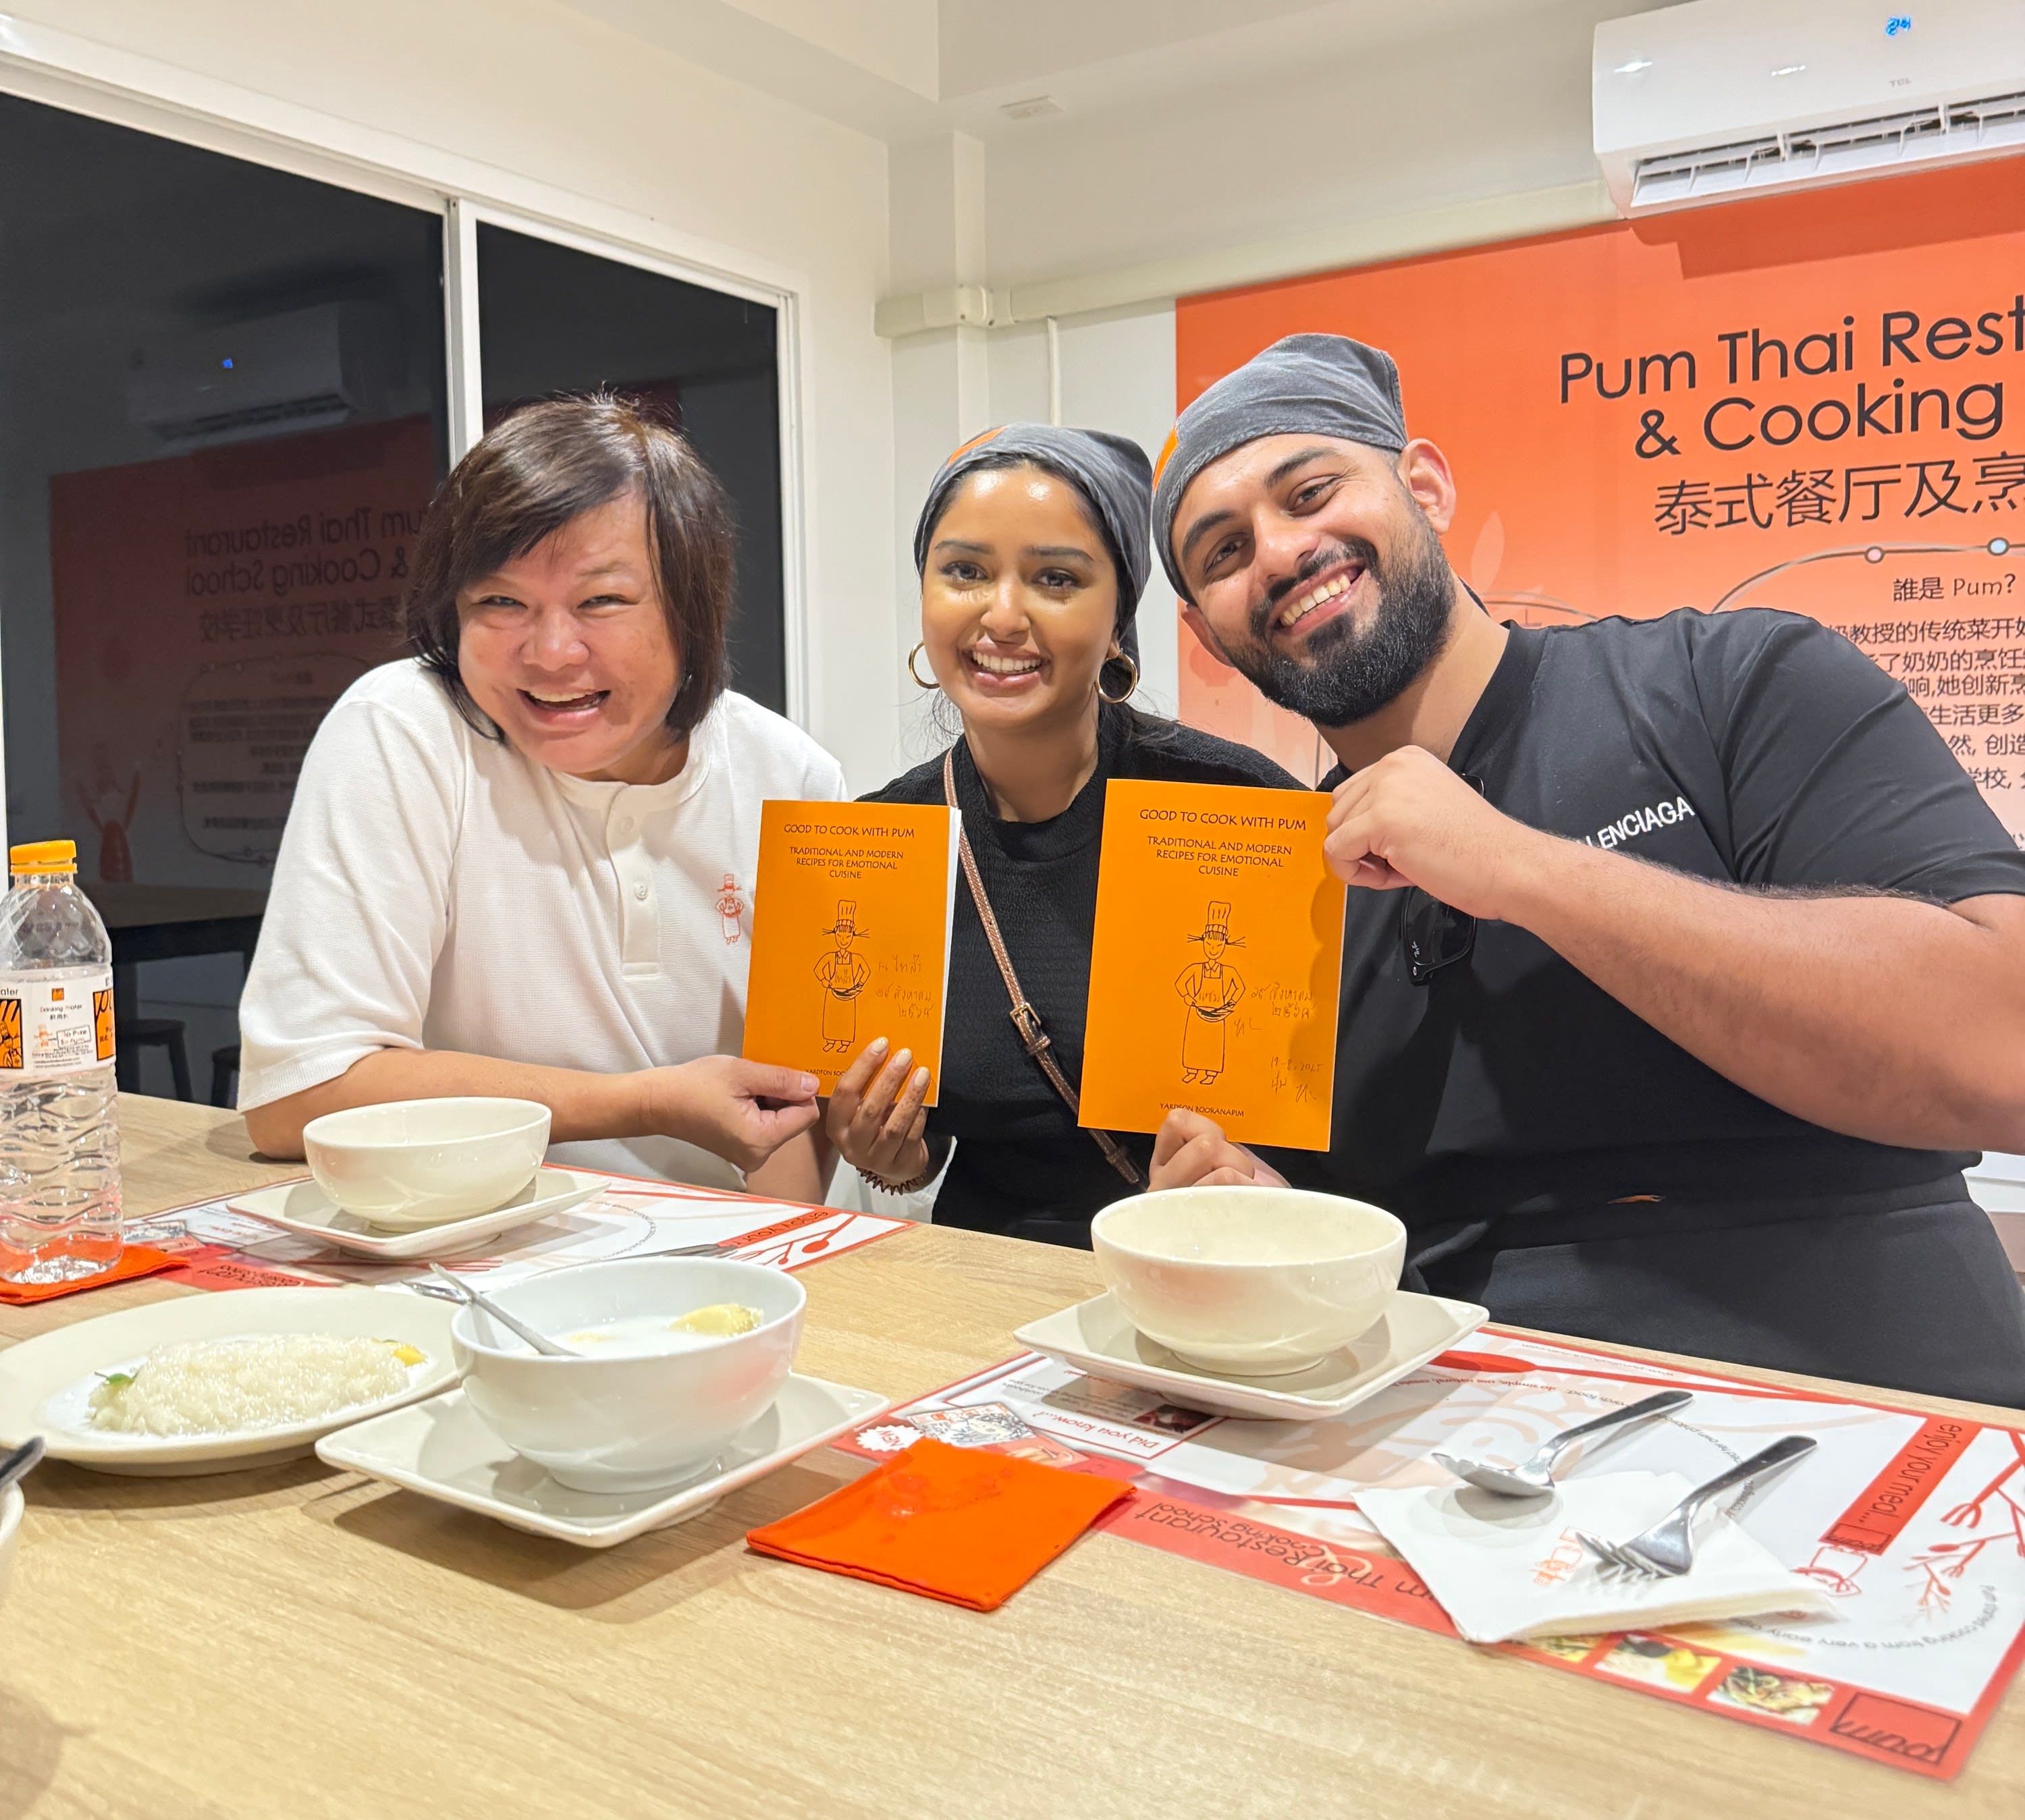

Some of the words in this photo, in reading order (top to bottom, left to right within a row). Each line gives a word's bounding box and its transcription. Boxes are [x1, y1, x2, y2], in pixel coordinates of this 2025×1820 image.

[1560, 351, 1696, 404] Pum
[1718, 315, 1855, 384] Thai
[1882, 294, 2025, 366] Rest
[1634, 409, 1681, 459] &
[1704, 378, 2003, 451] Cooking
[1654, 451, 2025, 535] 泰式餐厅及烹
[1953, 574, 2016, 597] Pum?
[1924, 703, 2024, 726] 生活更多
[1140, 809, 1177, 821] GOOD
[1181, 811, 1197, 823] TO
[1200, 812, 1238, 826] COOK
[1241, 816, 1274, 829] WITH
[1278, 818, 1307, 831] PUM
[784, 823, 812, 834] GOOD
[813, 825, 828, 835] TO
[829, 825, 860, 836] COOK
[861, 827, 889, 837] WITH
[892, 827, 915, 838] PUM
[789, 846, 844, 857] TRADITIONAL
[844, 848, 865, 858] AND
[866, 850, 904, 859] MODERN
[1147, 836, 1217, 850] TRADITIONAL
[1218, 842, 1243, 852] AND
[1245, 844, 1292, 856] MODERN
[795, 858, 826, 867] RECIPES
[828, 858, 844, 868] FOR
[845, 860, 898, 870] EMOTIONAL
[1156, 849, 1195, 860] RECIPES
[1197, 852, 1218, 862] FOR
[1220, 854, 1285, 868] EMOTIONAL
[829, 869, 862, 879] CUISINE
[1198, 865, 1239, 877] CUISINE
[1195, 1107, 1245, 1118] BOORANAPIM
[875, 1430, 905, 1447] NEW
[1098, 1426, 1130, 1439] you
[1129, 1435, 1160, 1449] Did
[1914, 1423, 1962, 1455] enjoy
[1895, 1454, 1937, 1483] your
[1135, 1507, 1308, 1569] Restaurant
[1312, 1559, 1384, 1589] Thai
